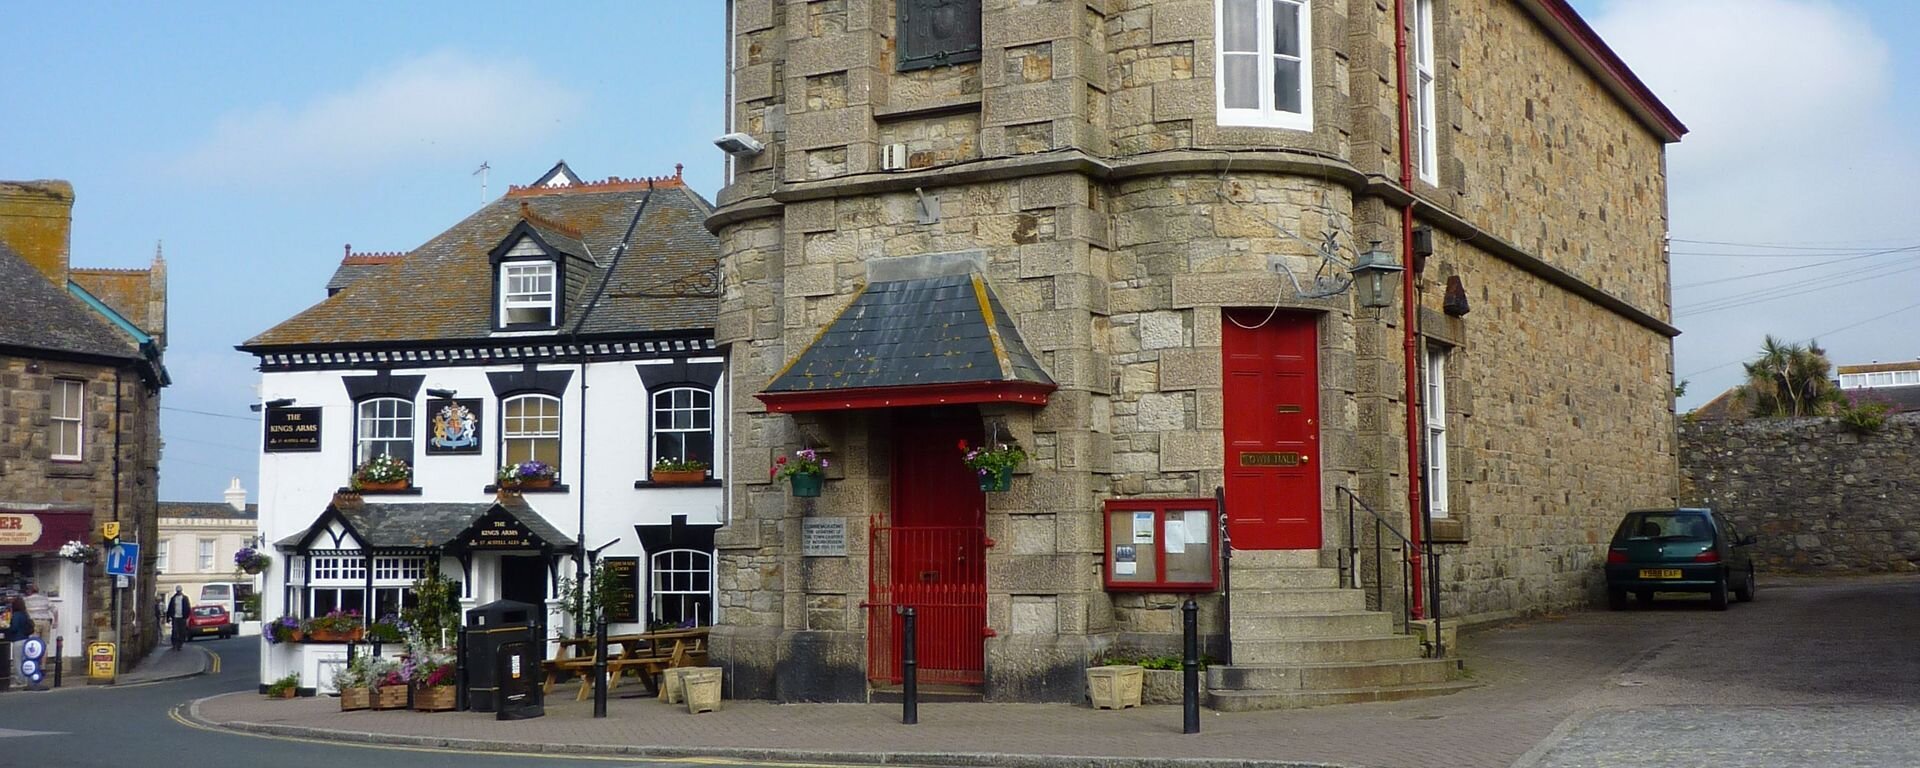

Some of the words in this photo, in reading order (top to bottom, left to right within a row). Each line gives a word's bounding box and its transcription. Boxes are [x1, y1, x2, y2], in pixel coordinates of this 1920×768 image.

[295, 424, 318, 432] ARMS
[1242, 454, 1271, 465] TOWN
[1274, 454, 1298, 464] HALL
